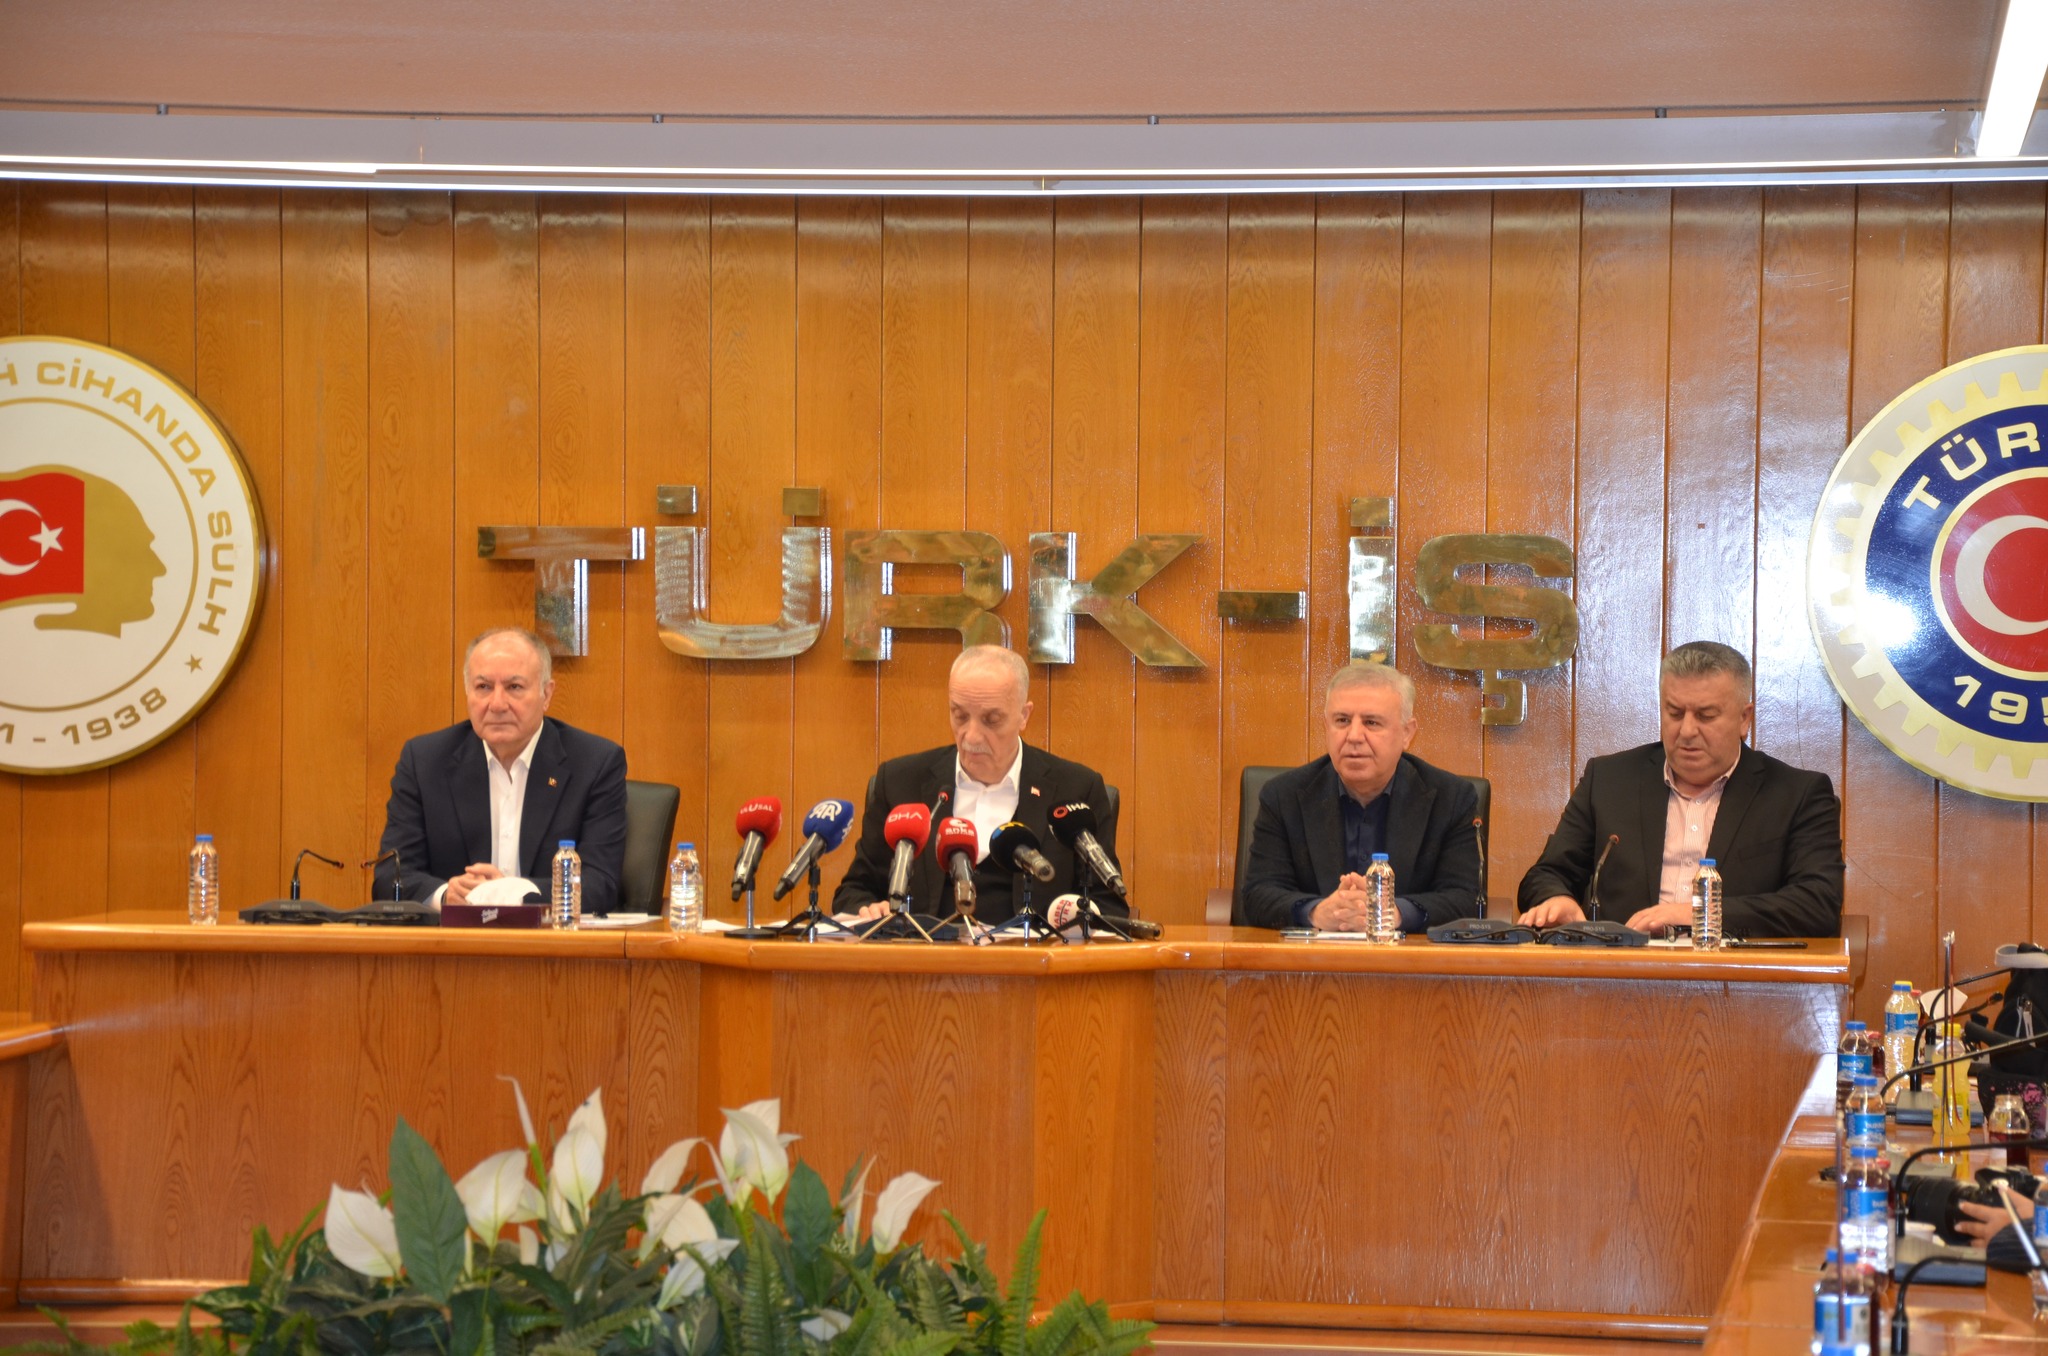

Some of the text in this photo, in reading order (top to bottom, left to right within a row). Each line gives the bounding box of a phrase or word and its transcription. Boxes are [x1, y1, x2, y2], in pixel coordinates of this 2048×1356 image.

[36, 358, 218, 497] CİHANDA
[197, 510, 233, 636] SULH
[61, 687, 167, 745] 1938
[1953, 675, 2048, 727] 19
[888, 812, 923, 823] DHA
